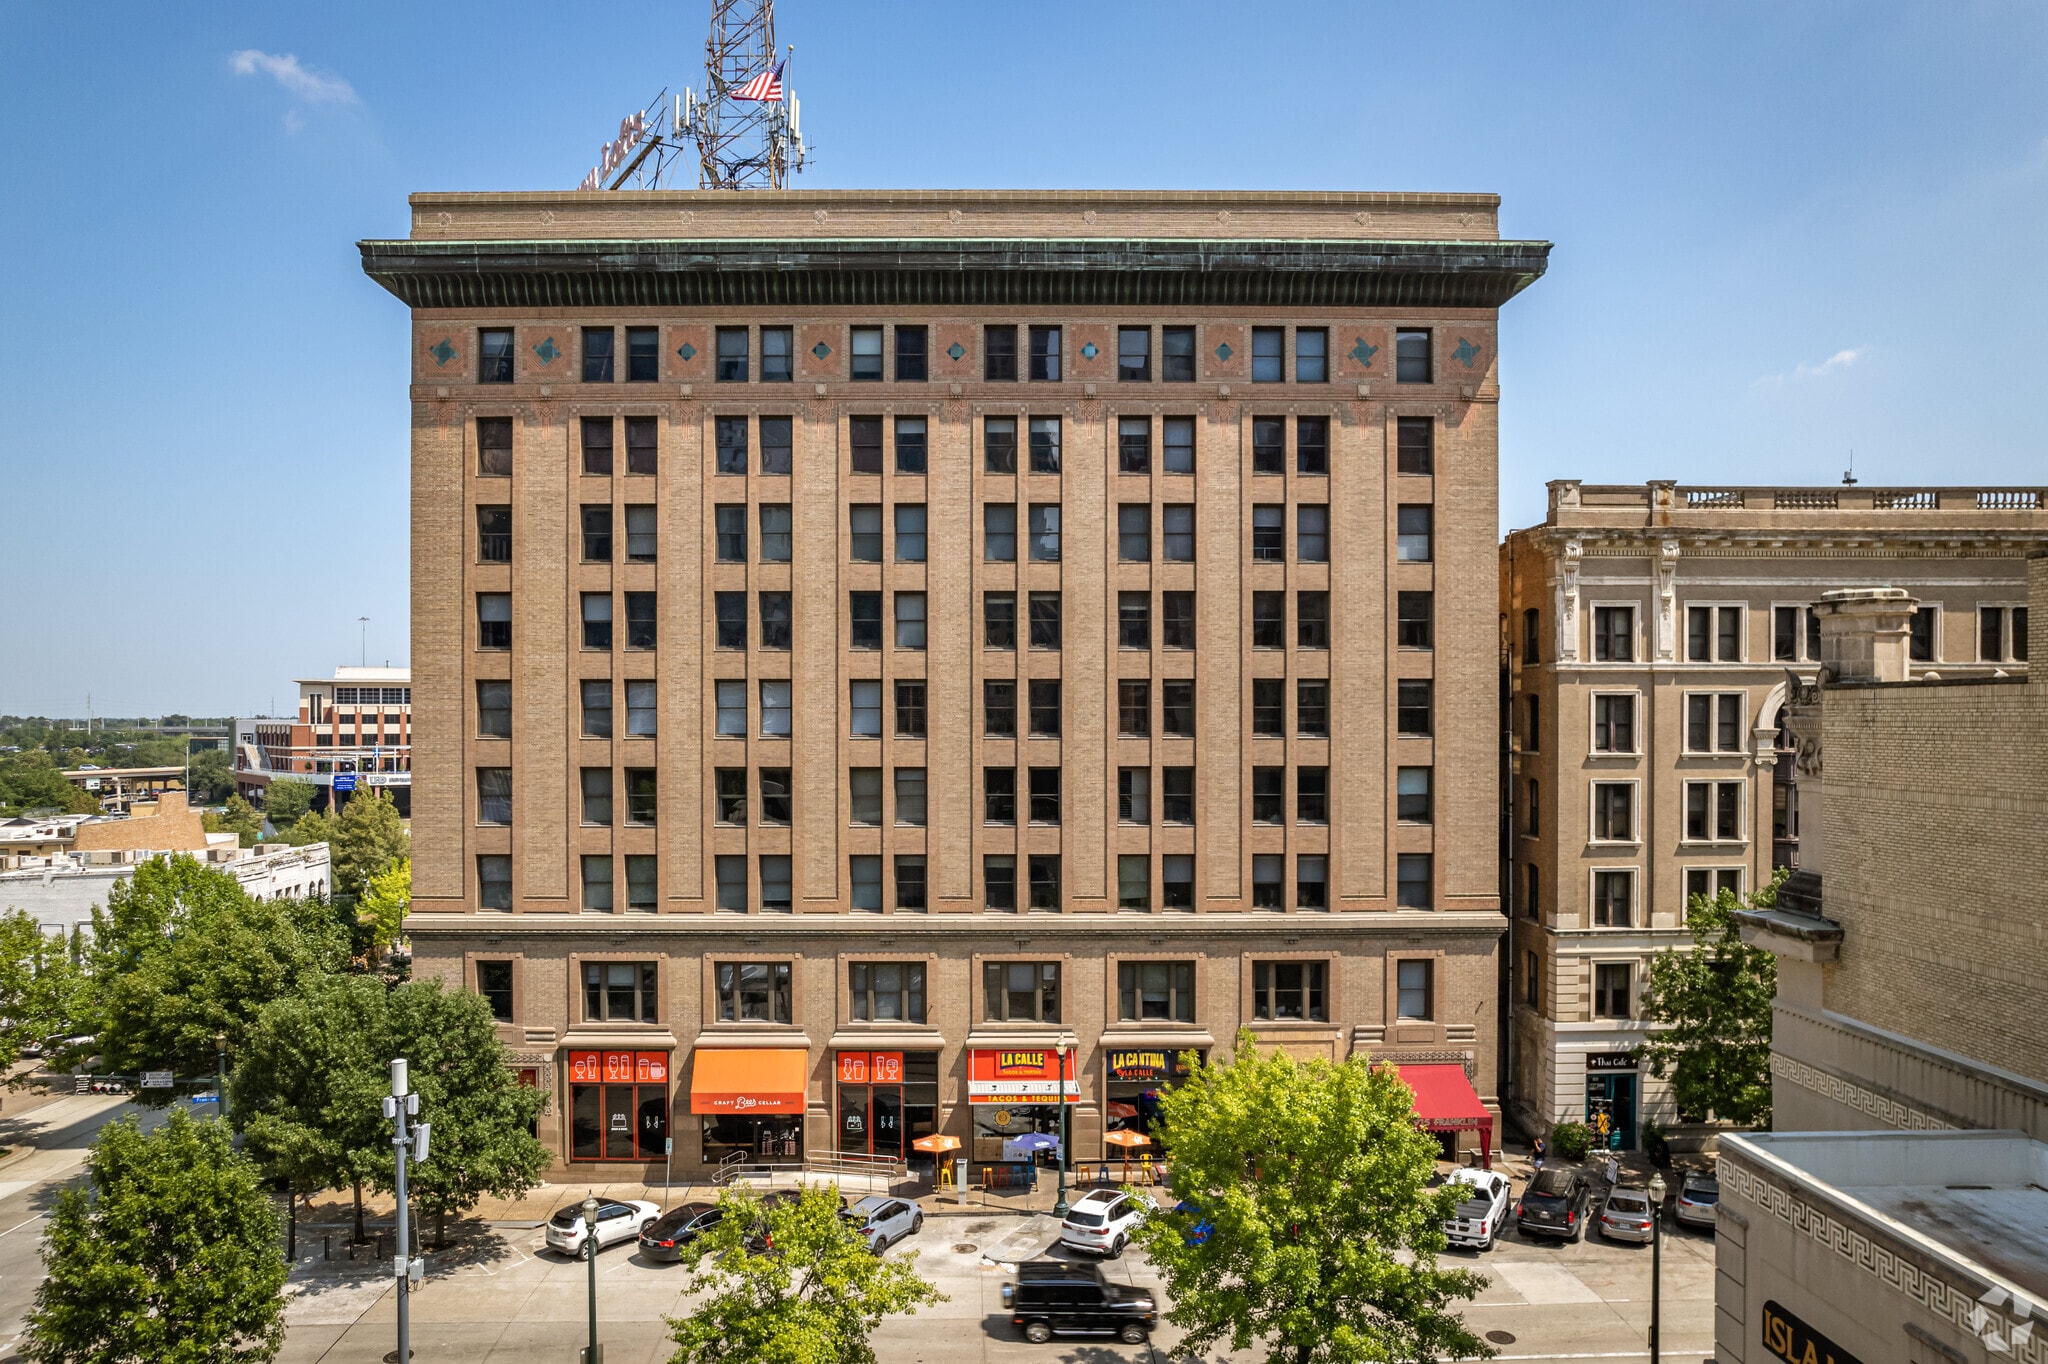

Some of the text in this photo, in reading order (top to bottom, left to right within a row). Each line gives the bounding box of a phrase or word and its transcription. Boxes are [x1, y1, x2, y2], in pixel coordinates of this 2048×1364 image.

[1001, 1053, 1043, 1066] LA CALLE
[1112, 1053, 1125, 1069] LA
[1126, 1052, 1166, 1069] CANTINA
[1596, 1057, 1611, 1066] Thai
[1433, 1117, 1478, 1126] FRANKLIN
[1764, 1309, 1836, 1364] ISLA
